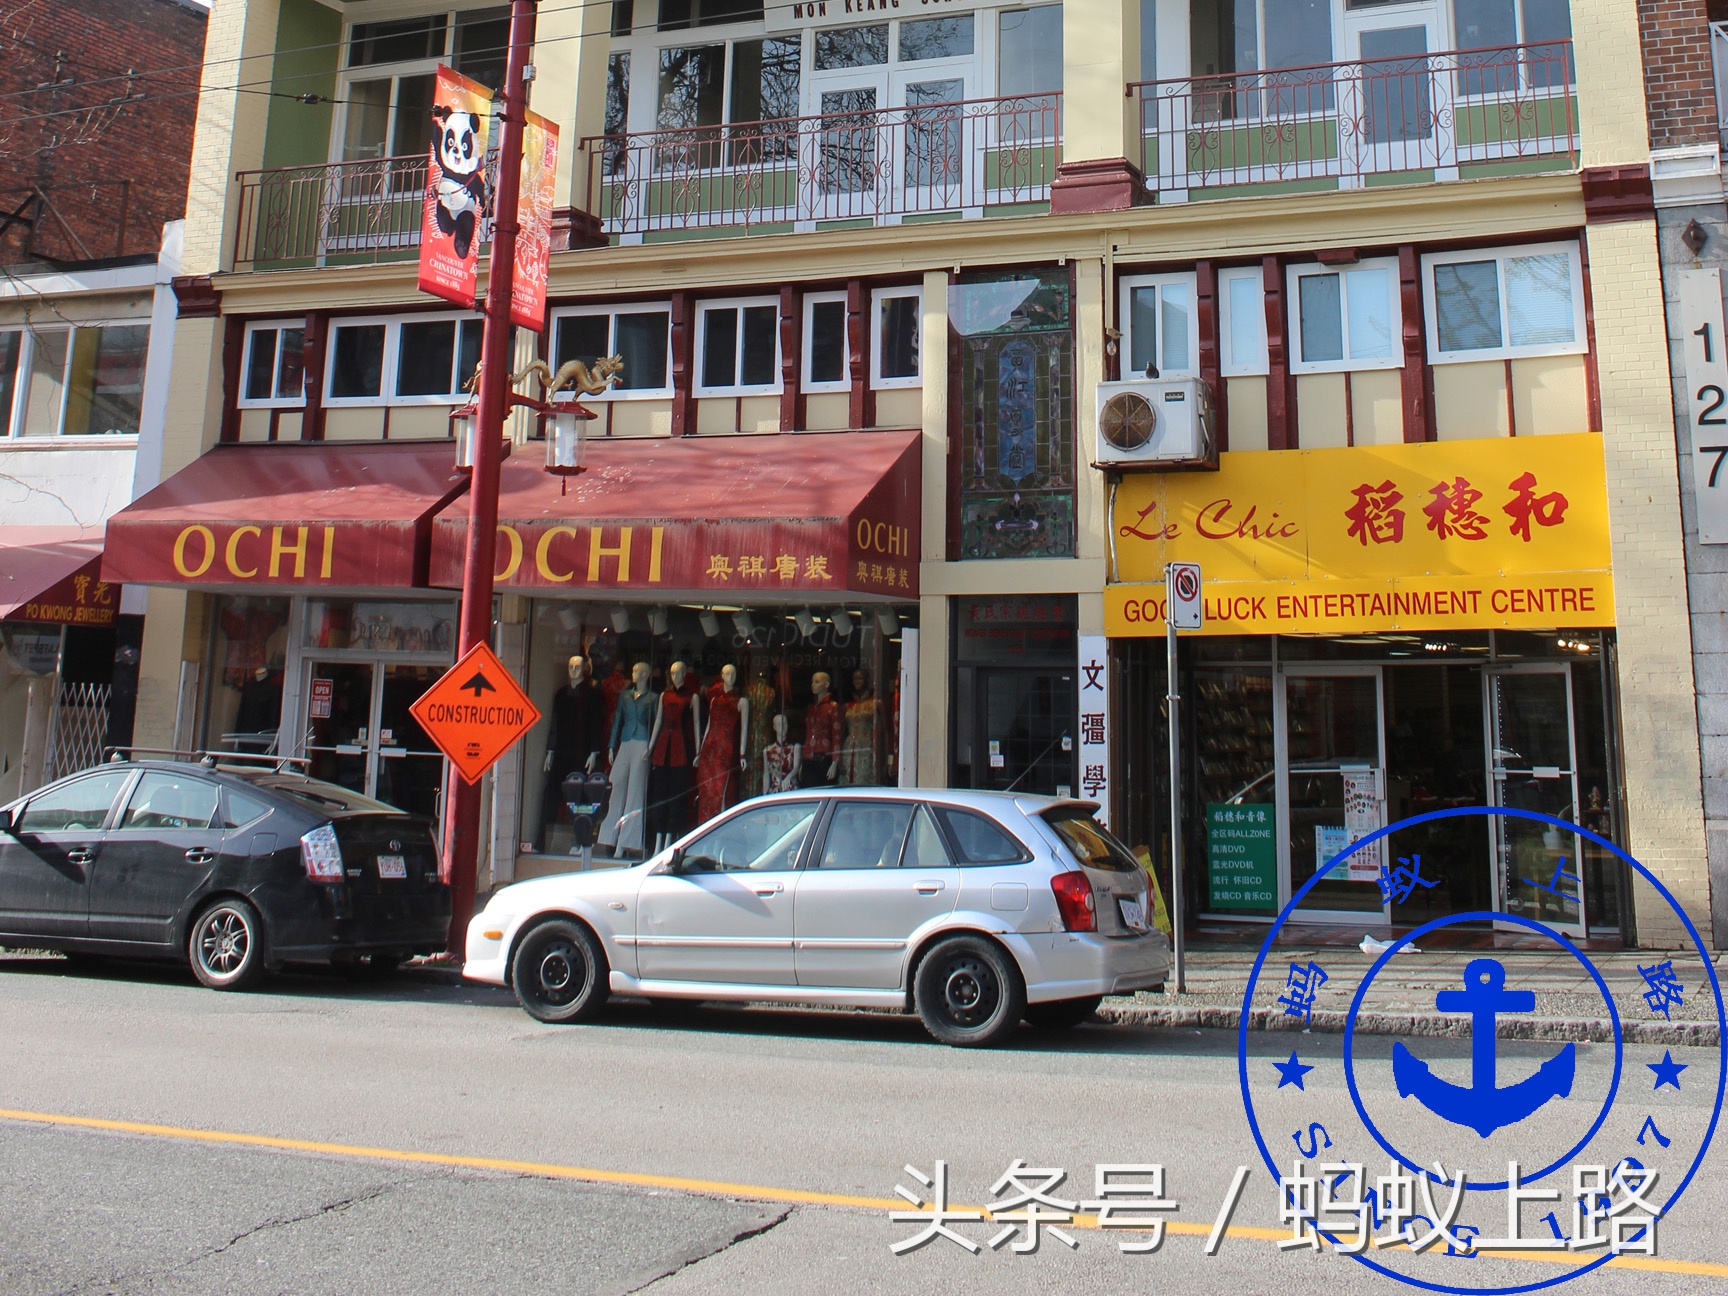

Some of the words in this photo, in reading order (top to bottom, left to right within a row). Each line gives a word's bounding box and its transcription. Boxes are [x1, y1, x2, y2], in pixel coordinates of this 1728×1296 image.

[794, 2, 827, 20] MON
[430, 258, 468, 280] CHINATOWN
[436, 252, 464, 268] VANCOUVER
[1346, 471, 1569, 547] 稻穗和
[1119, 500, 1182, 541] Le
[1195, 499, 1299, 540] Chic
[857, 519, 908, 556] OCHI
[173, 525, 334, 578] OCHI
[493, 525, 664, 582] OCHI
[26, 604, 39, 618] PO
[40, 604, 73, 620] KWONG
[74, 607, 114, 623] JEWELLERY
[1204, 596, 1267, 621] LUCK
[1277, 590, 1482, 619] ENTERTAINMENT
[1491, 587, 1595, 614] CENTRE
[315, 686, 330, 695] OPEN
[428, 704, 524, 725] CONSTRUCTION
[1212, 844, 1246, 854] 高清DVD
[1212, 860, 1254, 870] 蓝光DVD机
